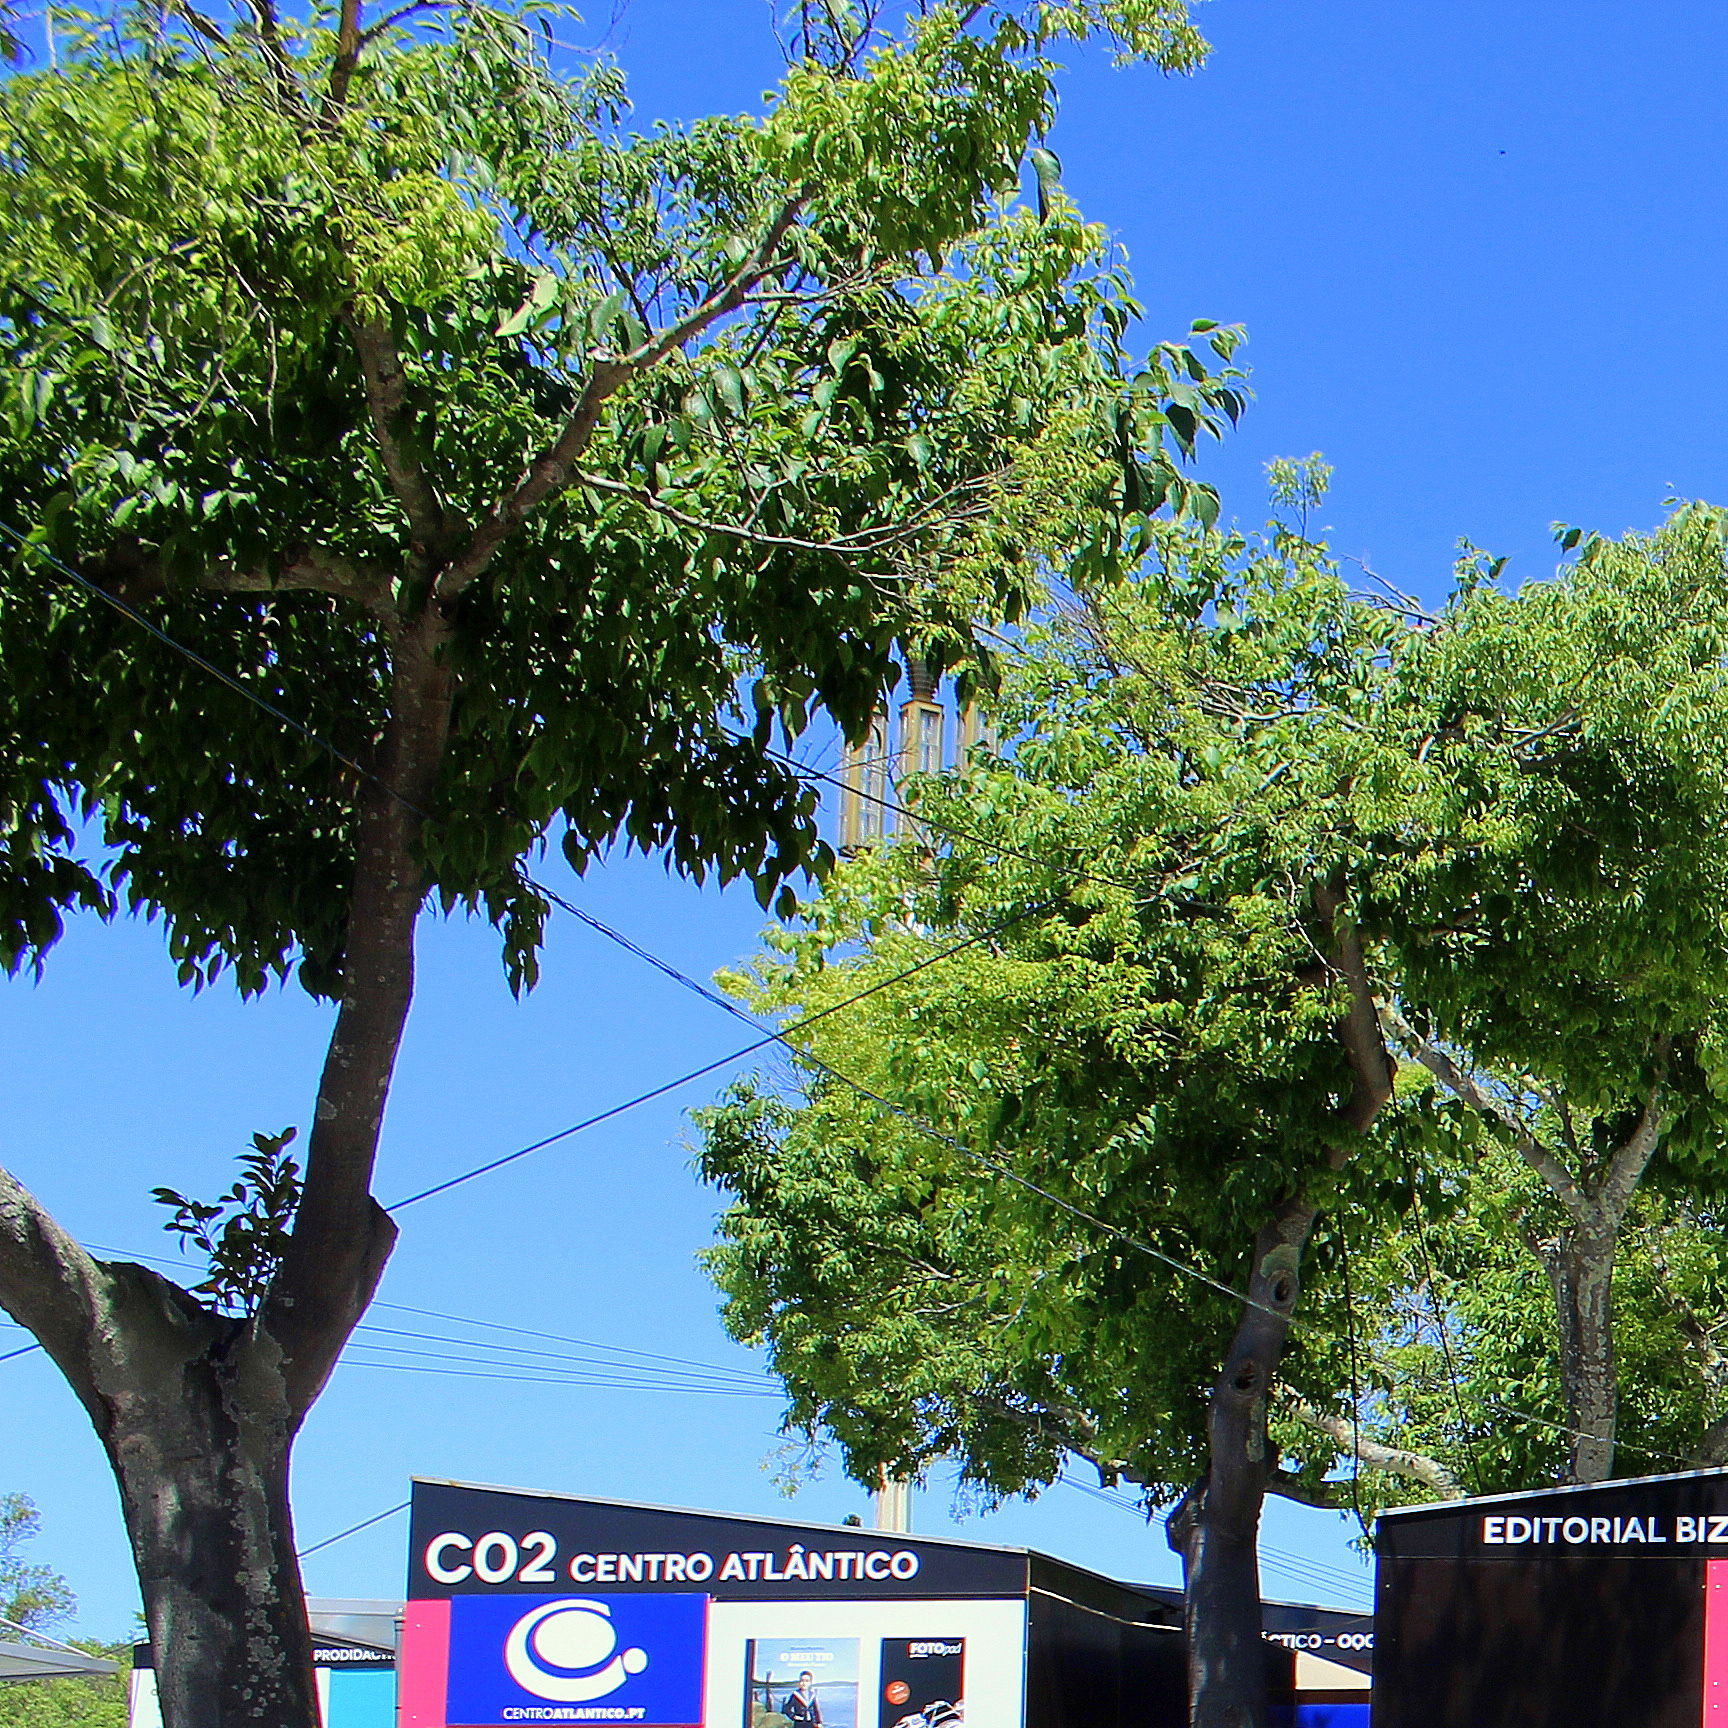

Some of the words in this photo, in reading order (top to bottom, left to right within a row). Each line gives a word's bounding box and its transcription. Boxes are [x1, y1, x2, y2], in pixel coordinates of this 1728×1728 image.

[1483, 1516, 1667, 1544] EDITORIAL
[570, 1552, 715, 1582] CENTRO
[718, 1543, 920, 1581] ATLÂNTICO
